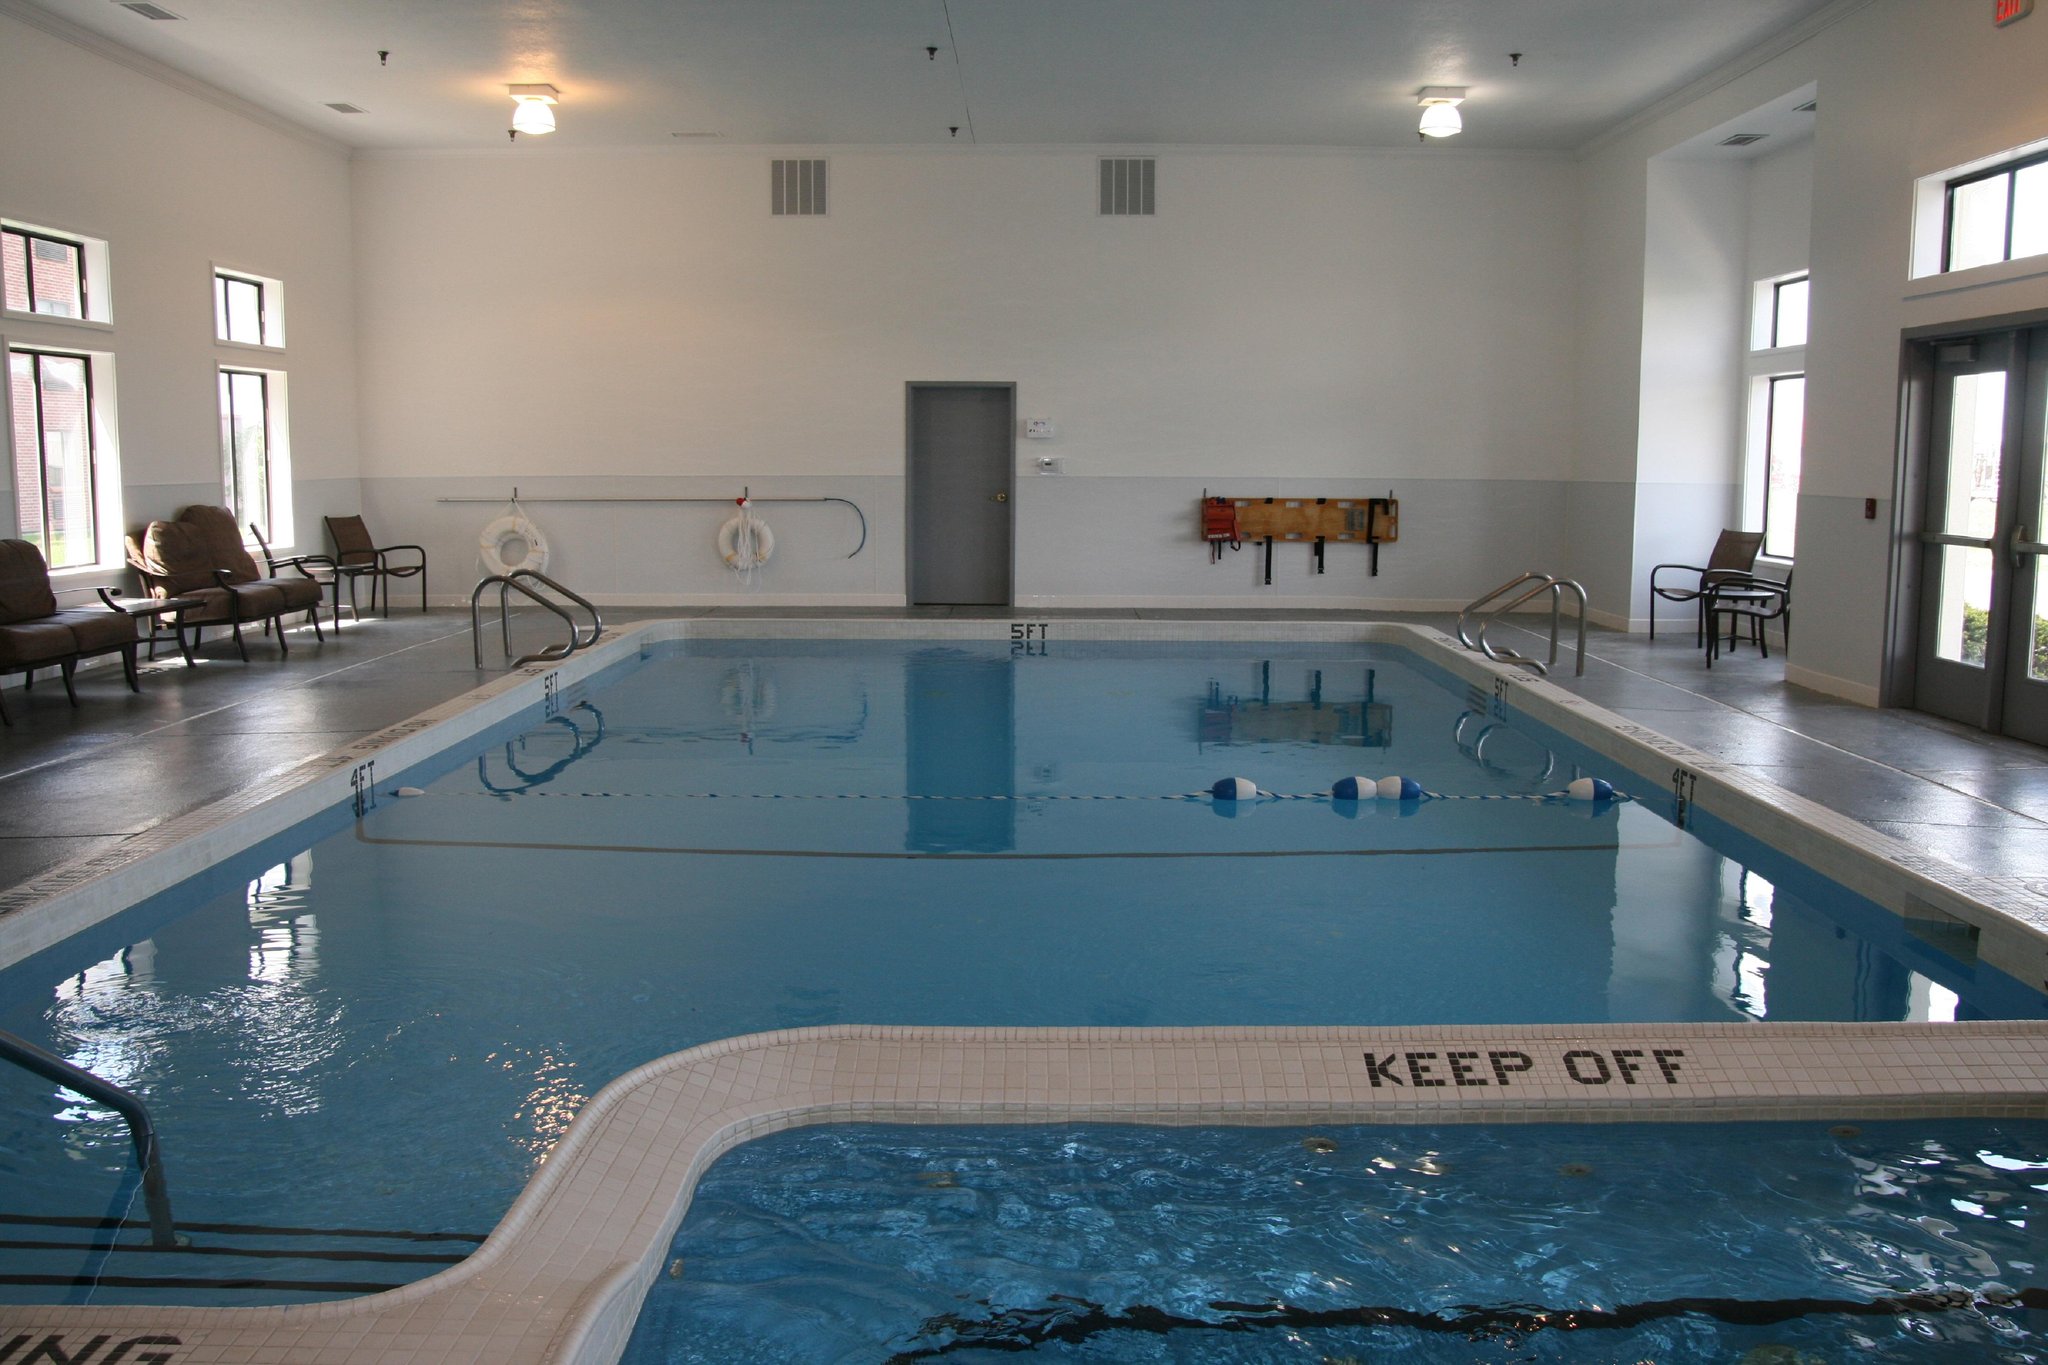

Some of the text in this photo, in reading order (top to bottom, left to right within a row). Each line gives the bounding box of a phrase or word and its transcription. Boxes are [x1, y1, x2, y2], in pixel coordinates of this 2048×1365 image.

[1011, 623, 1049, 639] 5FT
[545, 671, 559, 699] 5FT
[1494, 677, 1509, 702] 5FT
[350, 760, 375, 793] 4FT
[1672, 767, 1697, 802] 4FT
[1363, 1049, 1685, 1087] KEEP OFF
